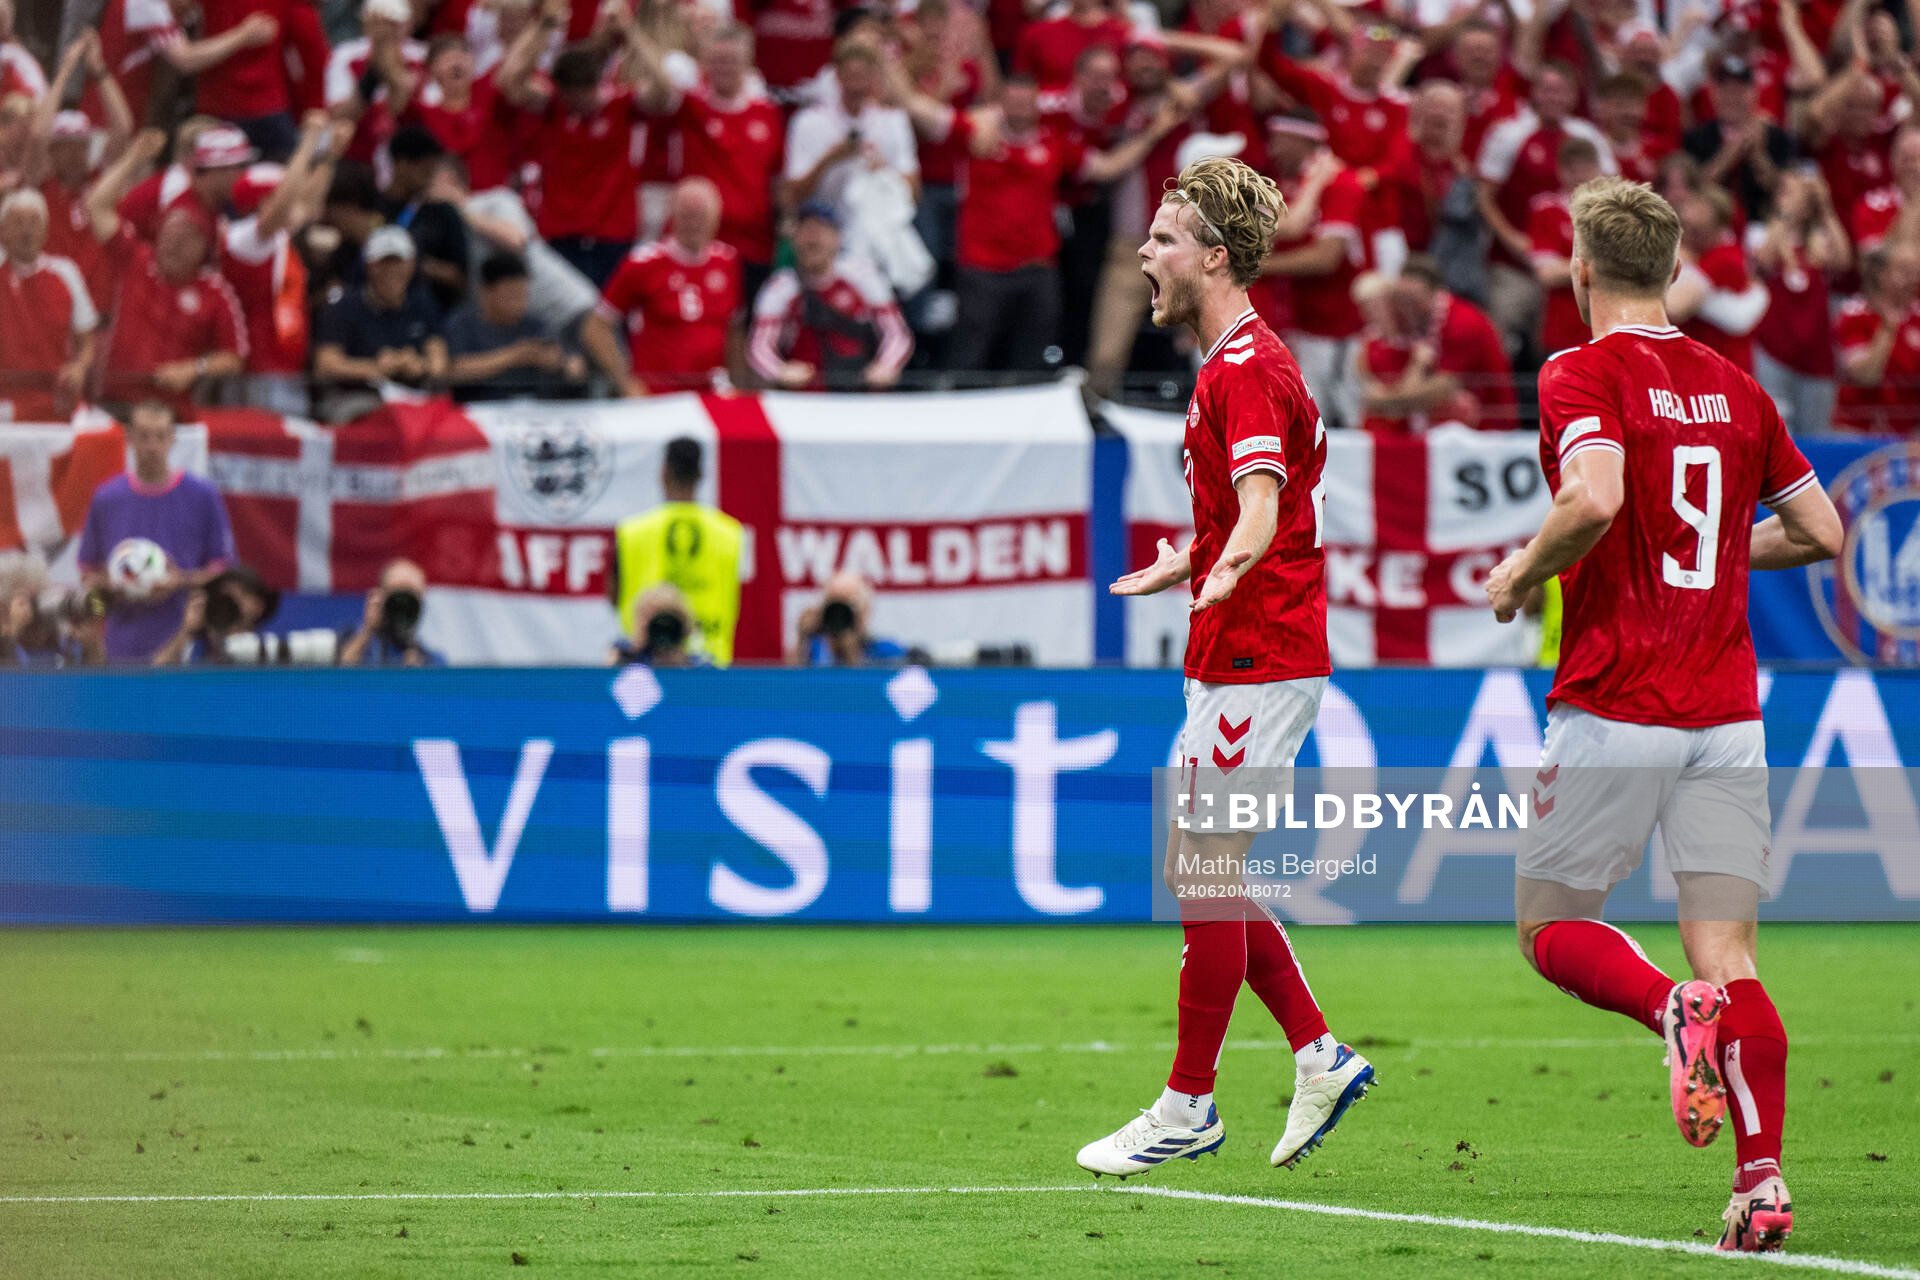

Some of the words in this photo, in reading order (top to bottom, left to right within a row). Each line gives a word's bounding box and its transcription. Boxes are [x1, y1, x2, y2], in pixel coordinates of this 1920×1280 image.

[1456, 456, 1541, 512] SO
[1663, 446, 1722, 590] 9
[774, 519, 1071, 585] WALDEN
[410, 664, 1120, 916] visit
